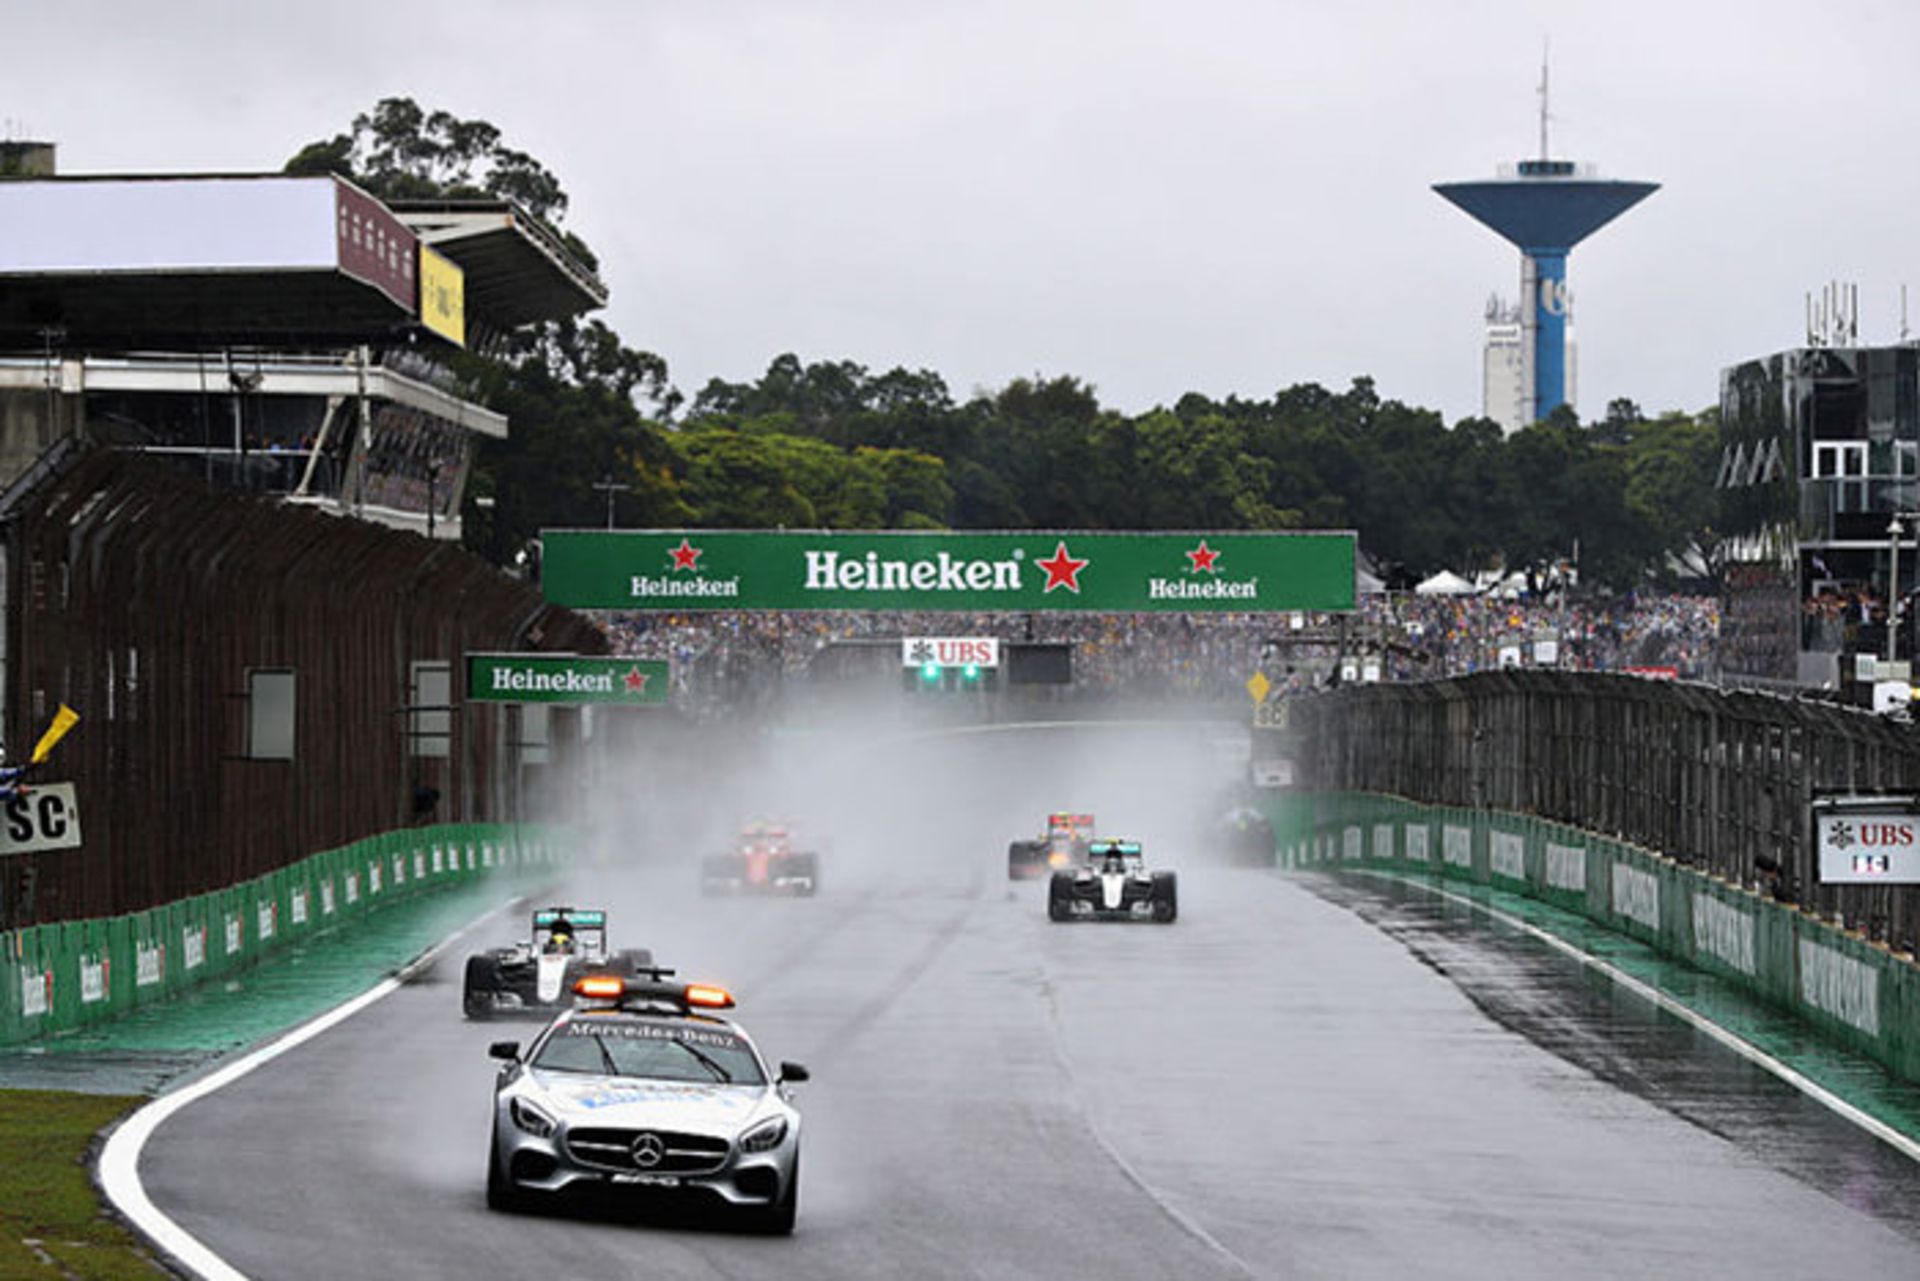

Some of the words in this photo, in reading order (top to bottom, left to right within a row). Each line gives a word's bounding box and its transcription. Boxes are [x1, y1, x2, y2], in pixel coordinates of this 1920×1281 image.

[804, 550, 1023, 591] Heineken
[630, 575, 739, 597] Heineken
[1149, 577, 1257, 599] Heineken
[937, 641, 992, 665] UBS
[492, 667, 615, 692] Heineken
[5, 794, 66, 842] SC
[1860, 823, 1914, 847] UBS
[567, 1022, 736, 1048] Mercedes-Benz
